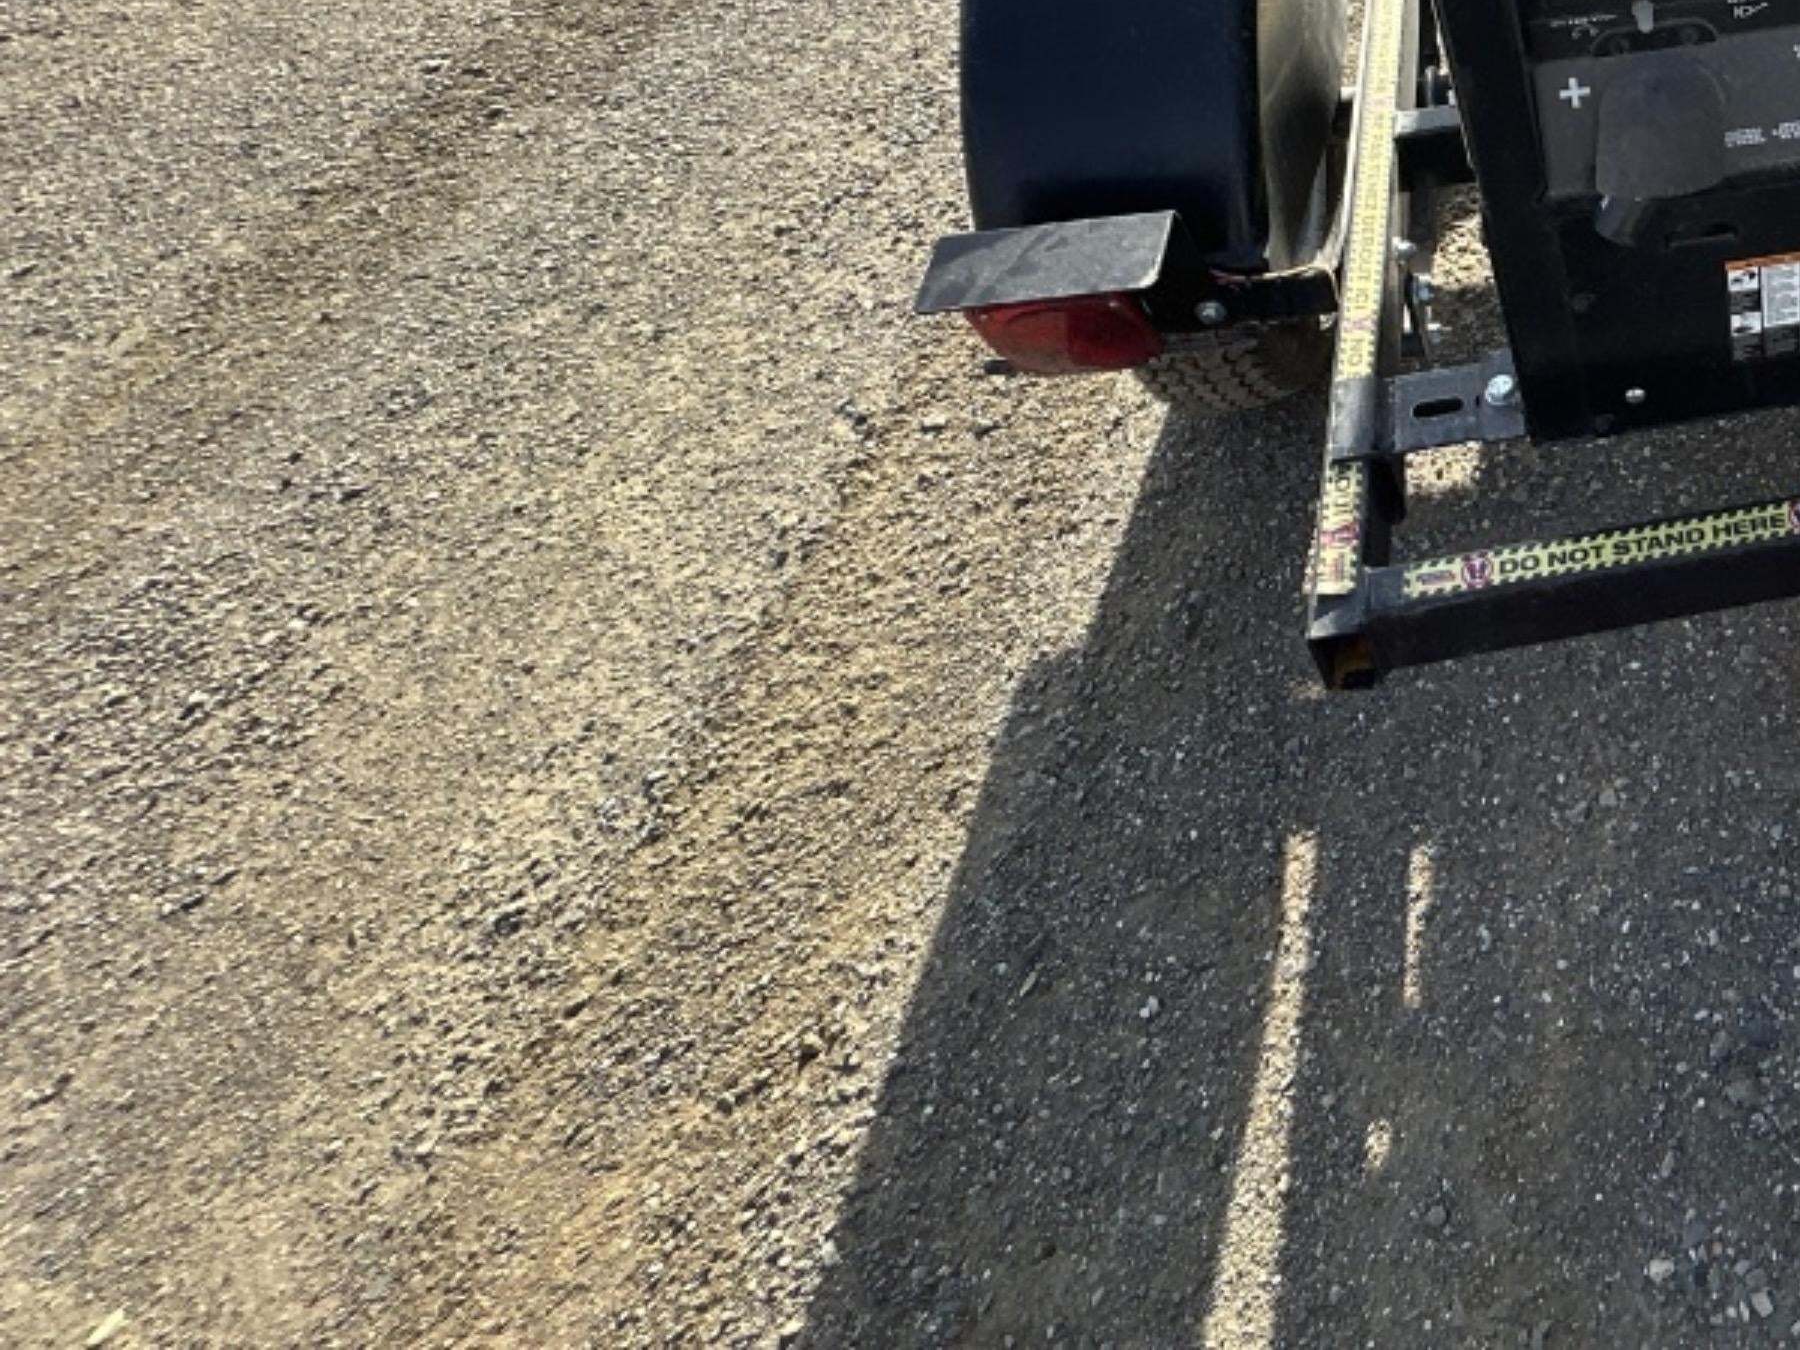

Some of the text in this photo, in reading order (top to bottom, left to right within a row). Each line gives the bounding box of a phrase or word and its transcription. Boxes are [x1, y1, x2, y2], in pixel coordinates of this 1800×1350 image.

[1347, 338, 1365, 367] NO
[1499, 514, 1787, 575] DO NOT STAND HERE
